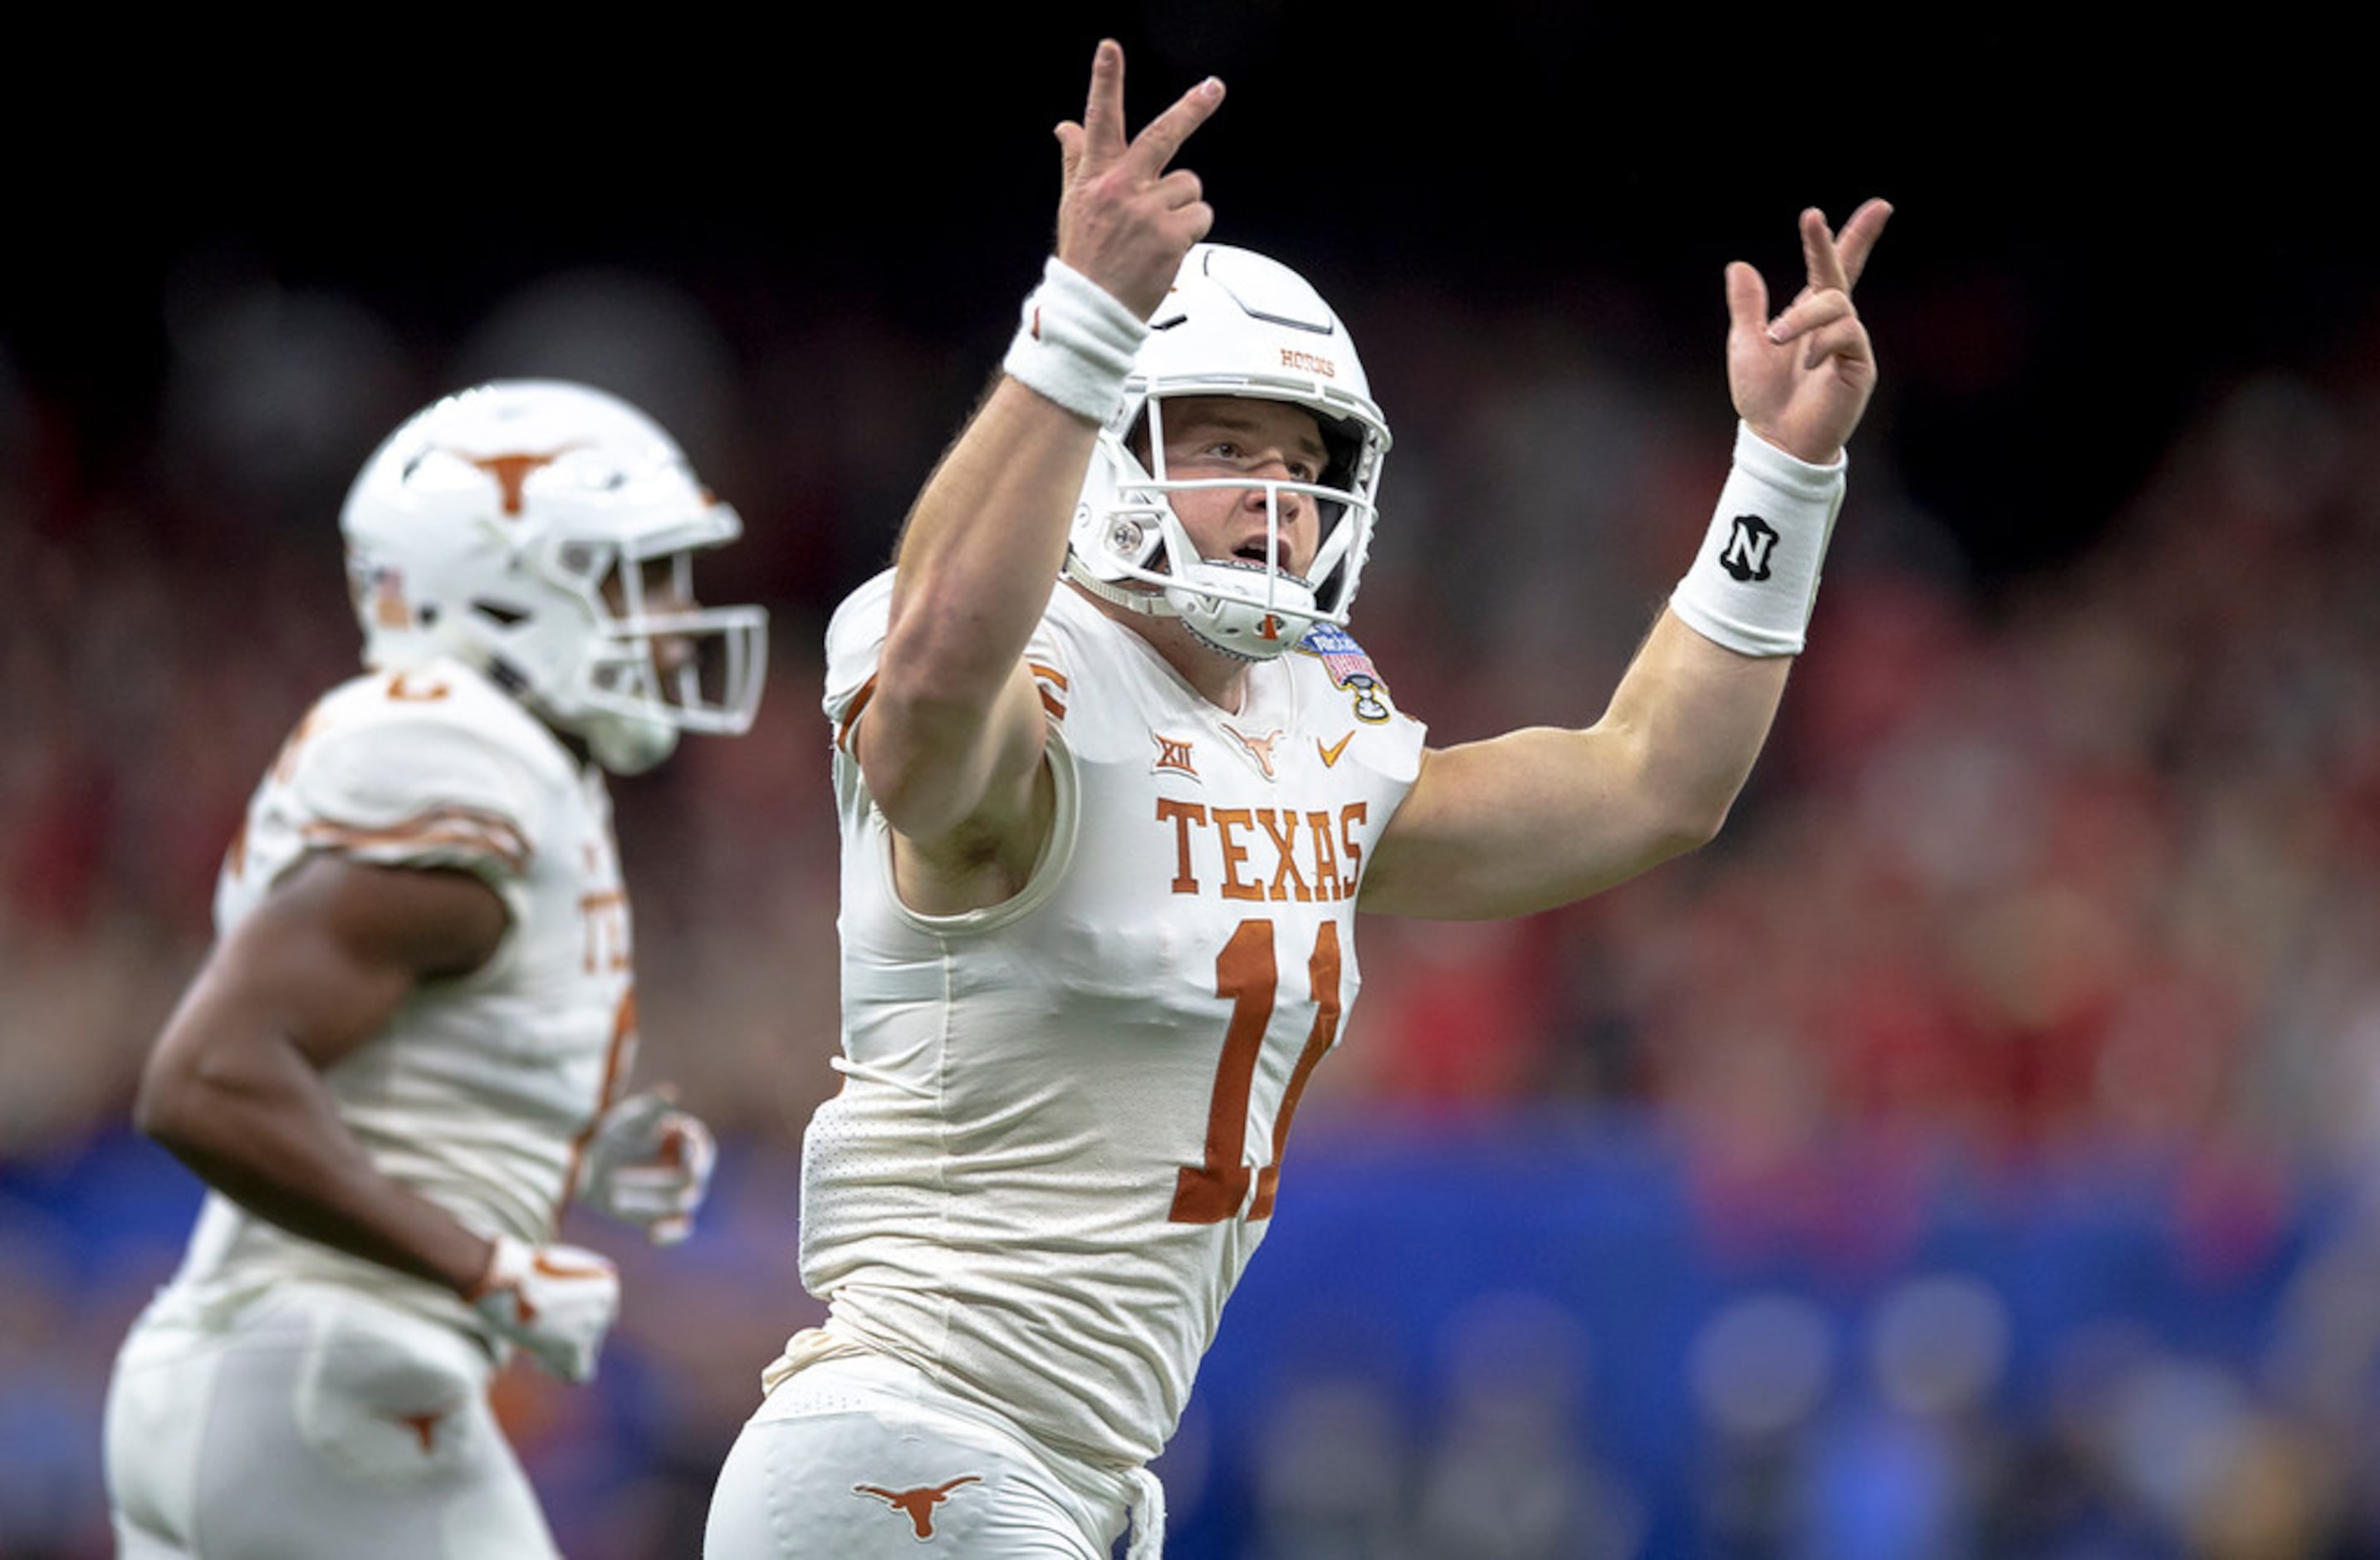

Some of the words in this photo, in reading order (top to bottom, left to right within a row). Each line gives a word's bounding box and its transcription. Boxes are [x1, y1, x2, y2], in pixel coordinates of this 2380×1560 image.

[1723, 518, 1775, 576] N
[1155, 733, 1199, 776] XII
[1155, 797, 1367, 902] TEXAS
[1168, 919, 1341, 1224] 11
